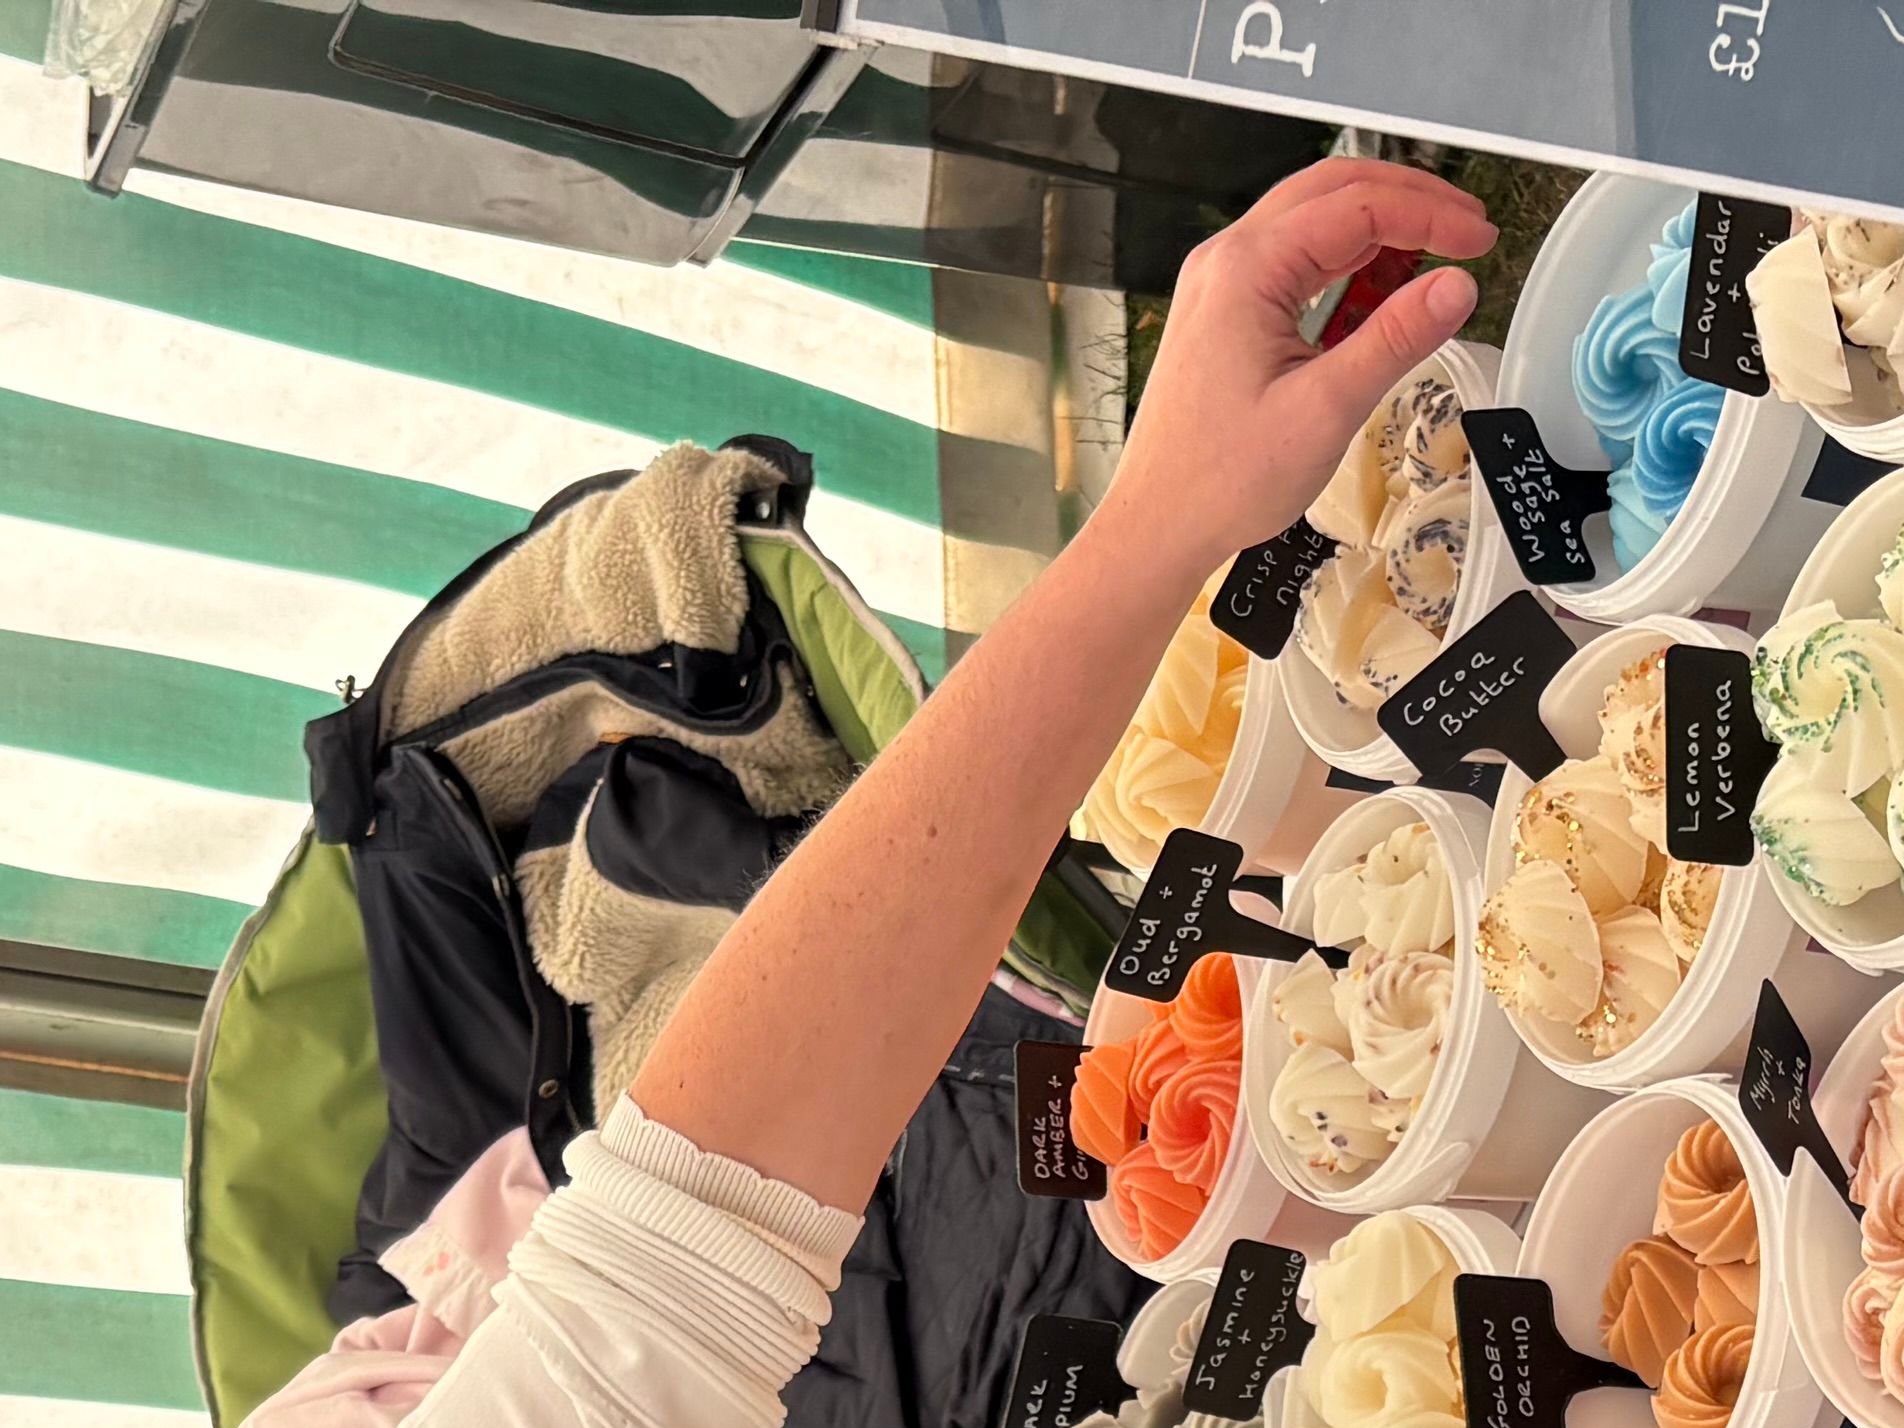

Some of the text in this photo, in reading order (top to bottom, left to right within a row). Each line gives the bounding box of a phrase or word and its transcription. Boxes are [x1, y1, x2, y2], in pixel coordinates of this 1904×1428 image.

[1690, 200, 1732, 359] Lavendar
[1496, 475, 1545, 562] Wood
[1230, 550, 1277, 617] Crisp
[1404, 651, 1496, 726] Cocoa
[1440, 656, 1526, 736] Butter
[1678, 722, 1702, 833] Lemon
[1714, 680, 1737, 821] Verbena
[1120, 918, 1162, 975] Oud
[1149, 862, 1219, 985] Bergamot
[1749, 1047, 1777, 1110] Myrrh
[1788, 1055, 1807, 1124] Tonka
[1032, 1117, 1050, 1178] DARK
[1048, 1099, 1066, 1177] AMBER
[1196, 1268, 1256, 1390] Jasmine
[1239, 1253, 1304, 1398] Honeysuckle
[1512, 1316, 1534, 1417] ORCHID
